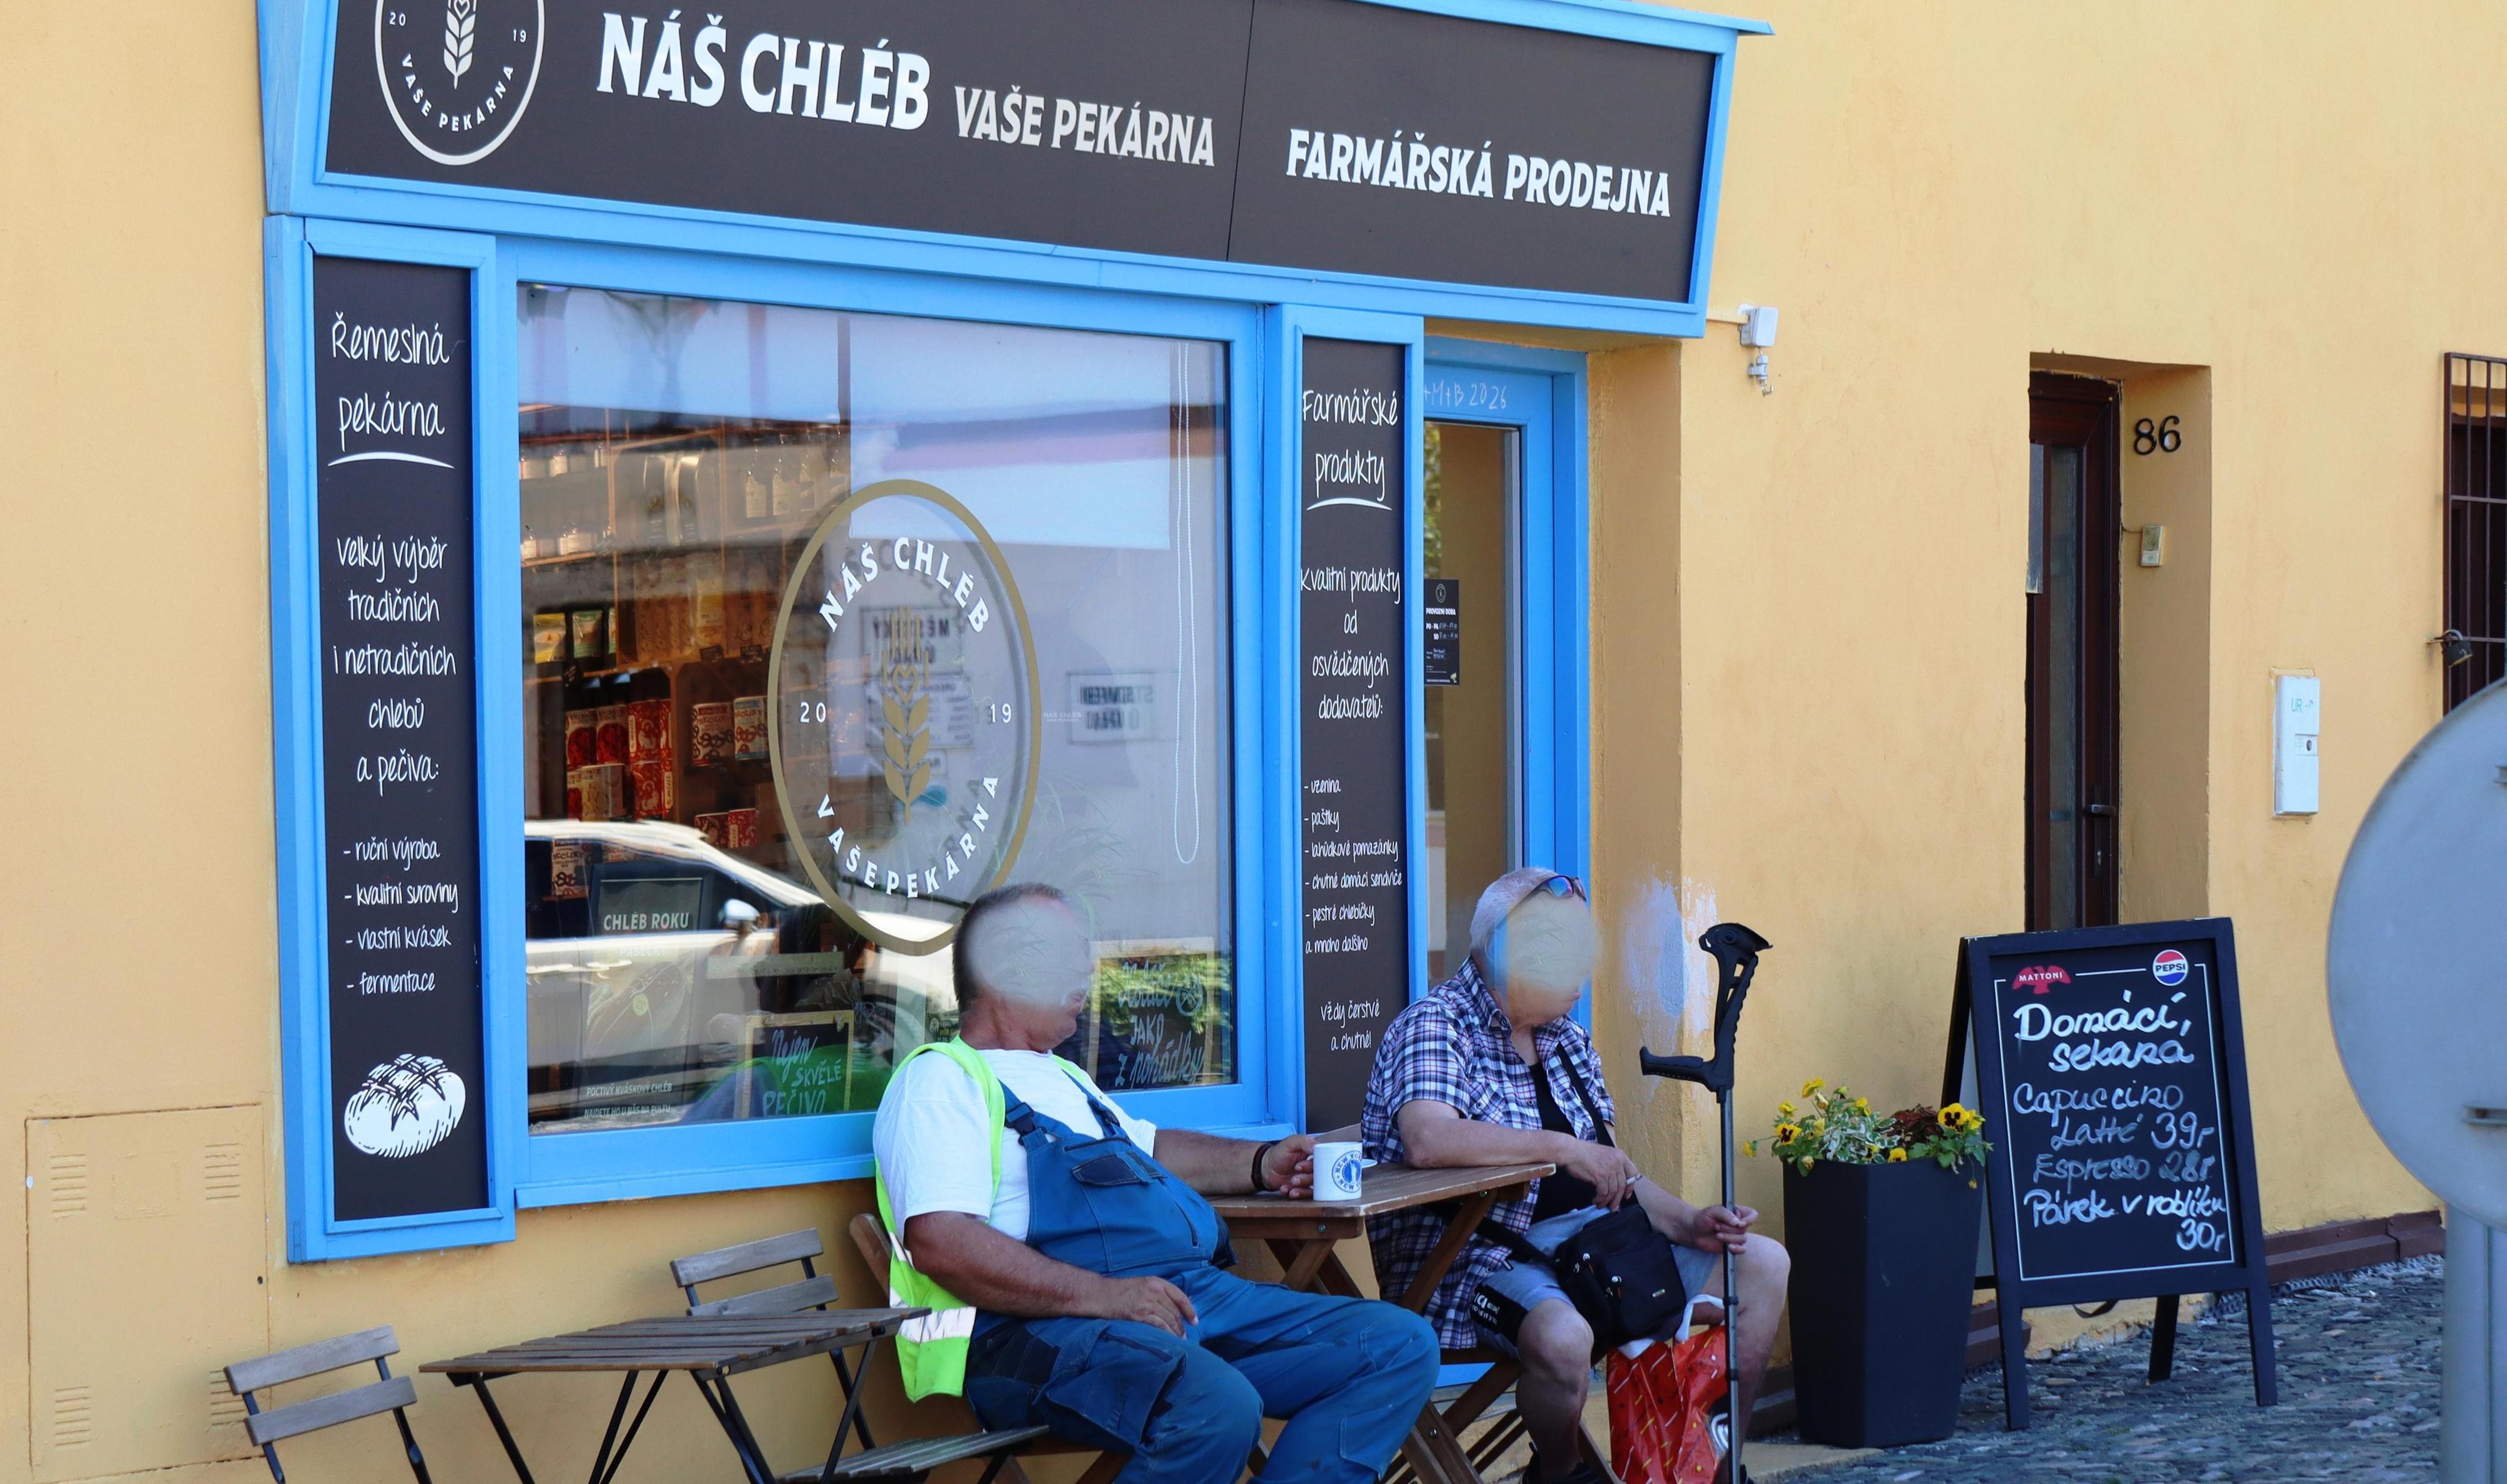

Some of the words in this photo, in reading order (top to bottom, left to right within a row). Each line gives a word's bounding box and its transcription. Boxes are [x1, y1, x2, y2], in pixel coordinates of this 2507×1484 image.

[389, 12, 406, 28] 20
[513, 29, 527, 43] 19
[596, 9, 726, 107] NÁŠ
[740, 38, 931, 130] CHLÉB
[402, 53, 431, 117] VAŠE
[439, 65, 514, 132] PEKÁRNA
[954, 85, 1042, 147] VAŠE
[1050, 98, 1215, 166] PEKÁRNA
[1285, 128, 1493, 198] FARMÁŘSKÁ
[1503, 154, 1671, 217] PRODEJNA
[332, 311, 450, 365] Řemeslná
[1303, 388, 1398, 426] Farmářské
[1469, 383, 1507, 409] 2026
[339, 391, 445, 452] pekárna
[2133, 415, 2182, 456] 86
[1316, 449, 1385, 502] produkty
[392, 535, 447, 583] výběr
[819, 542, 878, 633] NÁŠ
[893, 536, 990, 633] CHLÉB
[1350, 567, 1401, 604] produkty
[348, 588, 440, 622] tradičních
[1344, 609, 1358, 635] od
[333, 645, 339, 674] i
[345, 642, 456, 676] netradičních
[1312, 649, 1389, 689] osvědčených
[369, 698, 424, 729] chlebů
[800, 702, 827, 723] 20
[990, 703, 1012, 723] 19
[1318, 694, 1383, 719] dodavatelů:
[357, 756, 372, 783] a
[378, 749, 439, 797] pečiva:
[1311, 778, 1341, 793] uzenina
[1311, 808, 1339, 833] paštiky
[355, 836, 389, 861] ruční
[392, 836, 441, 870] výroba
[817, 794, 878, 888] VAŠE
[886, 777, 998, 898] PEKÁRNA
[1311, 840, 1351, 857] lahůdkové
[1353, 839, 1398, 863] pomazánky
[1312, 872, 1338, 890] chutné
[1340, 870, 1368, 889] domácí
[1370, 869, 1402, 887] sendviče
[356, 882, 402, 906] kvalitní
[407, 882, 459, 913] suroviny
[604, 912, 647, 931] CHLÉB
[651, 912, 689, 929] ROKU
[1312, 904, 1337, 929] pestré
[1339, 902, 1375, 926] chlebíčky
[357, 926, 401, 949] vlastní
[405, 924, 452, 949] kvásek
[1306, 940, 1312, 954] a
[1314, 937, 1339, 954] mnoho
[1342, 934, 1368, 953] dalšího
[359, 970, 436, 995] fermentace
[2019, 971, 2063, 982] MATTONI
[2155, 963, 2185, 972] PEPSI
[1348, 998, 1380, 1019] čerstvé
[1331, 1036, 1339, 1051] a
[791, 1058, 842, 1087] SKVĚLÉ
[587, 1084, 614, 1097] POCTIVÝ
[651, 1080, 673, 1092] CHLÉB
[2033, 1153, 2150, 1194] Espresso
[2023, 1188, 2115, 1228] Párek
[2122, 1194, 2143, 1214] v
